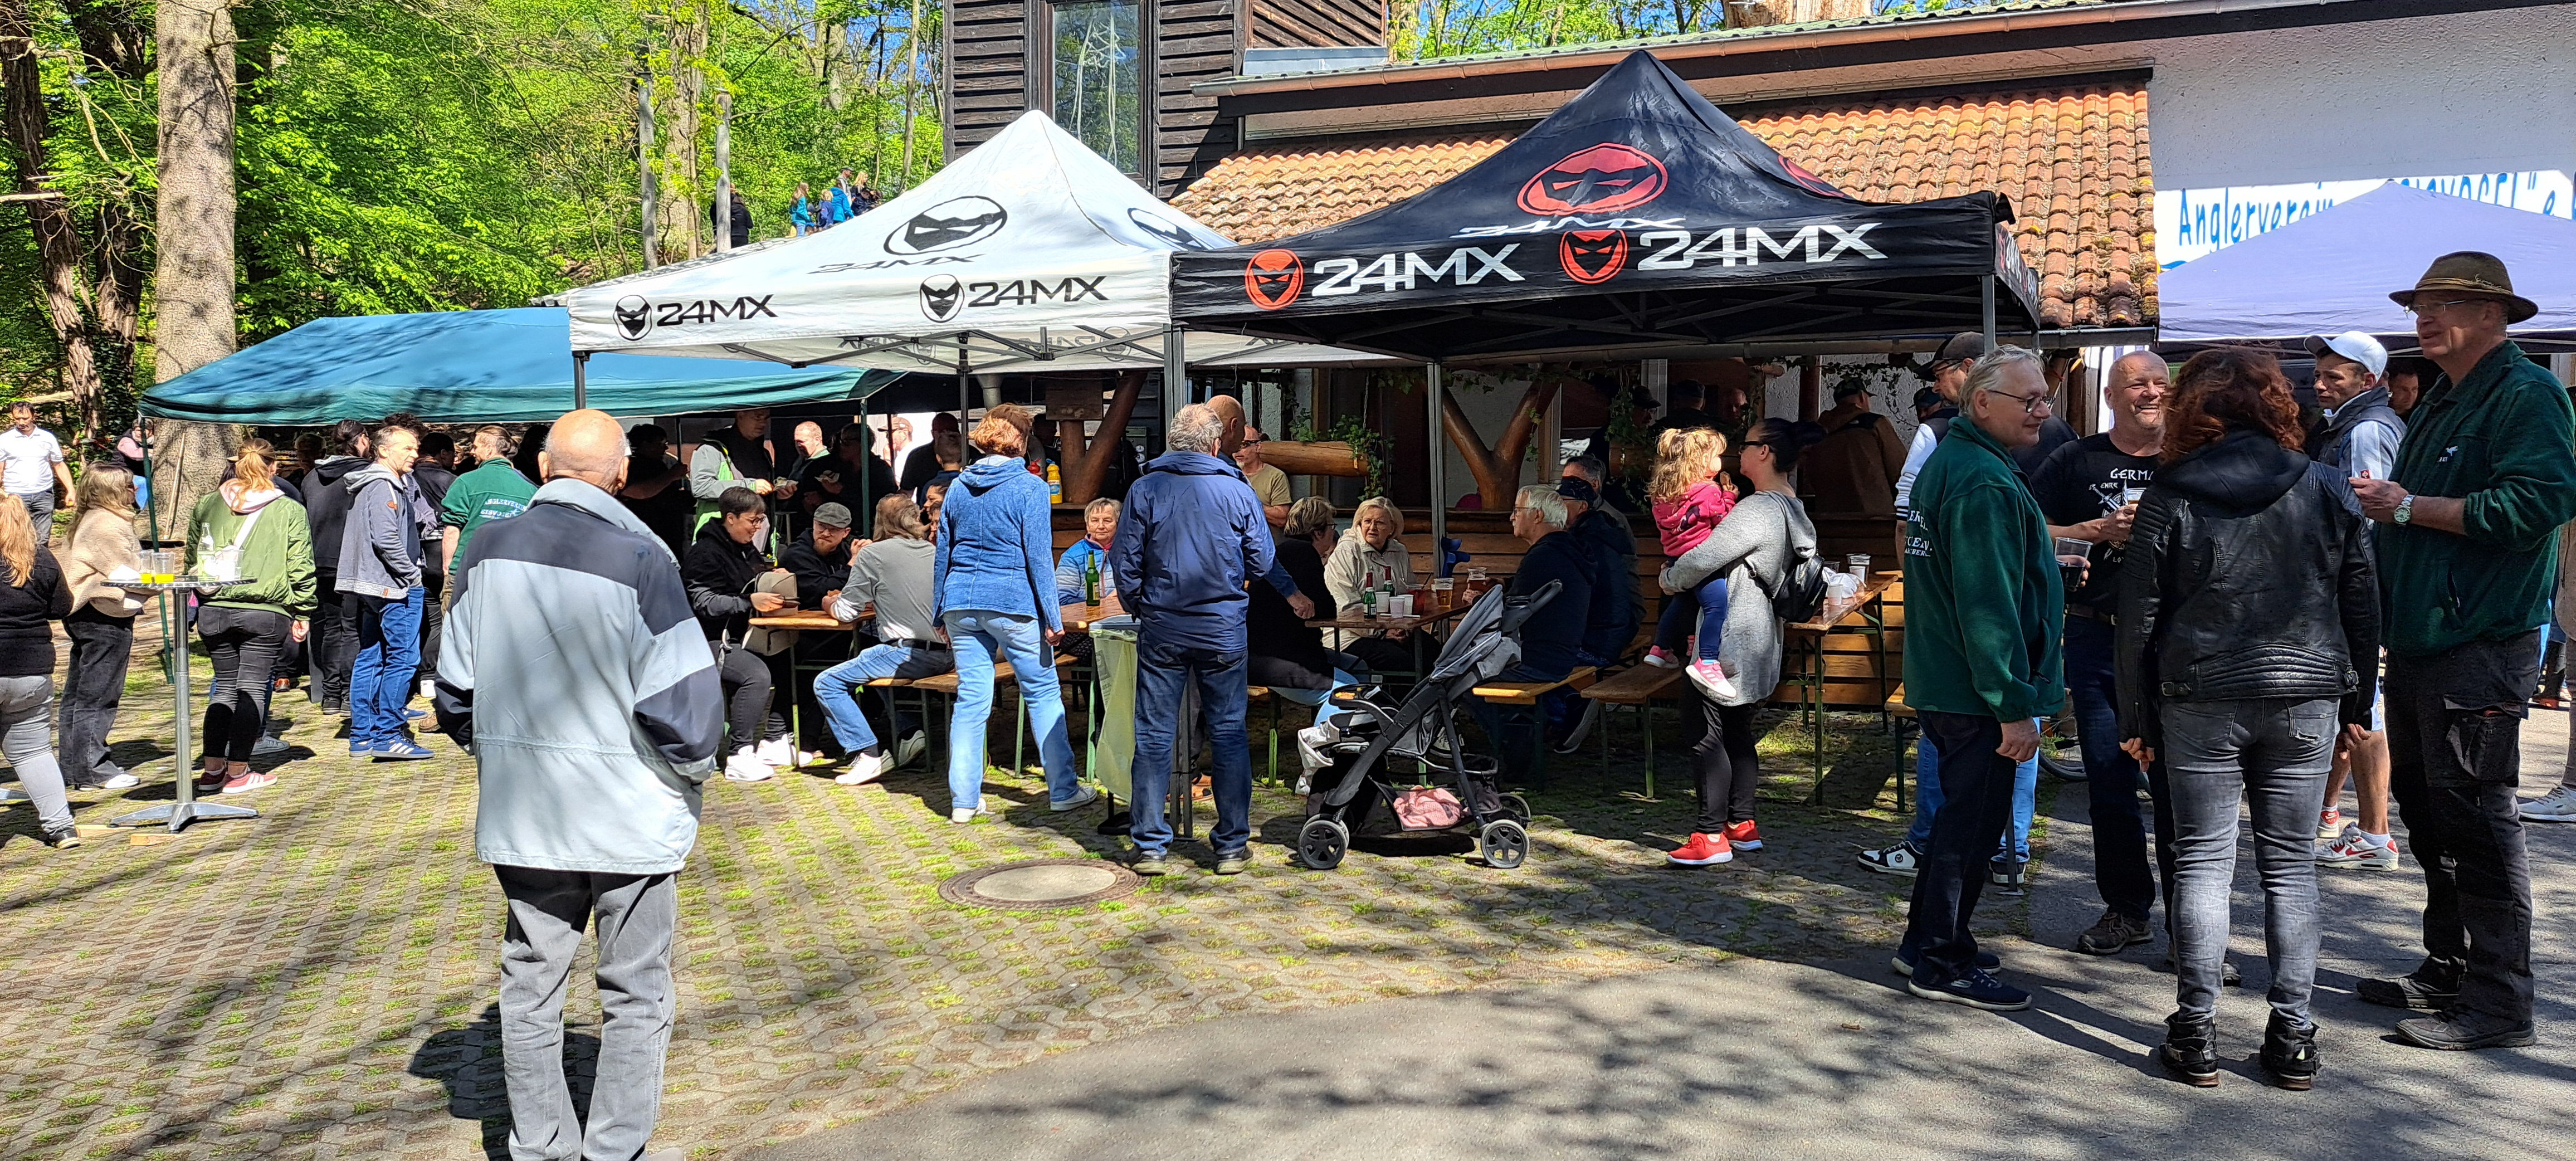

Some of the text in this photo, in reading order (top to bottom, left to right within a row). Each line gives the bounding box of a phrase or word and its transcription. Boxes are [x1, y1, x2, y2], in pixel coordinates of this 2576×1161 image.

[1449, 216, 1686, 238] 24MX
[2179, 181, 2333, 251] Anglerver
[1637, 222, 1889, 271] 24MX
[806, 253, 987, 275] 24MX
[1311, 243, 1526, 296] 24MX
[967, 275, 1111, 308] 24MX
[656, 294, 779, 327] 24MX
